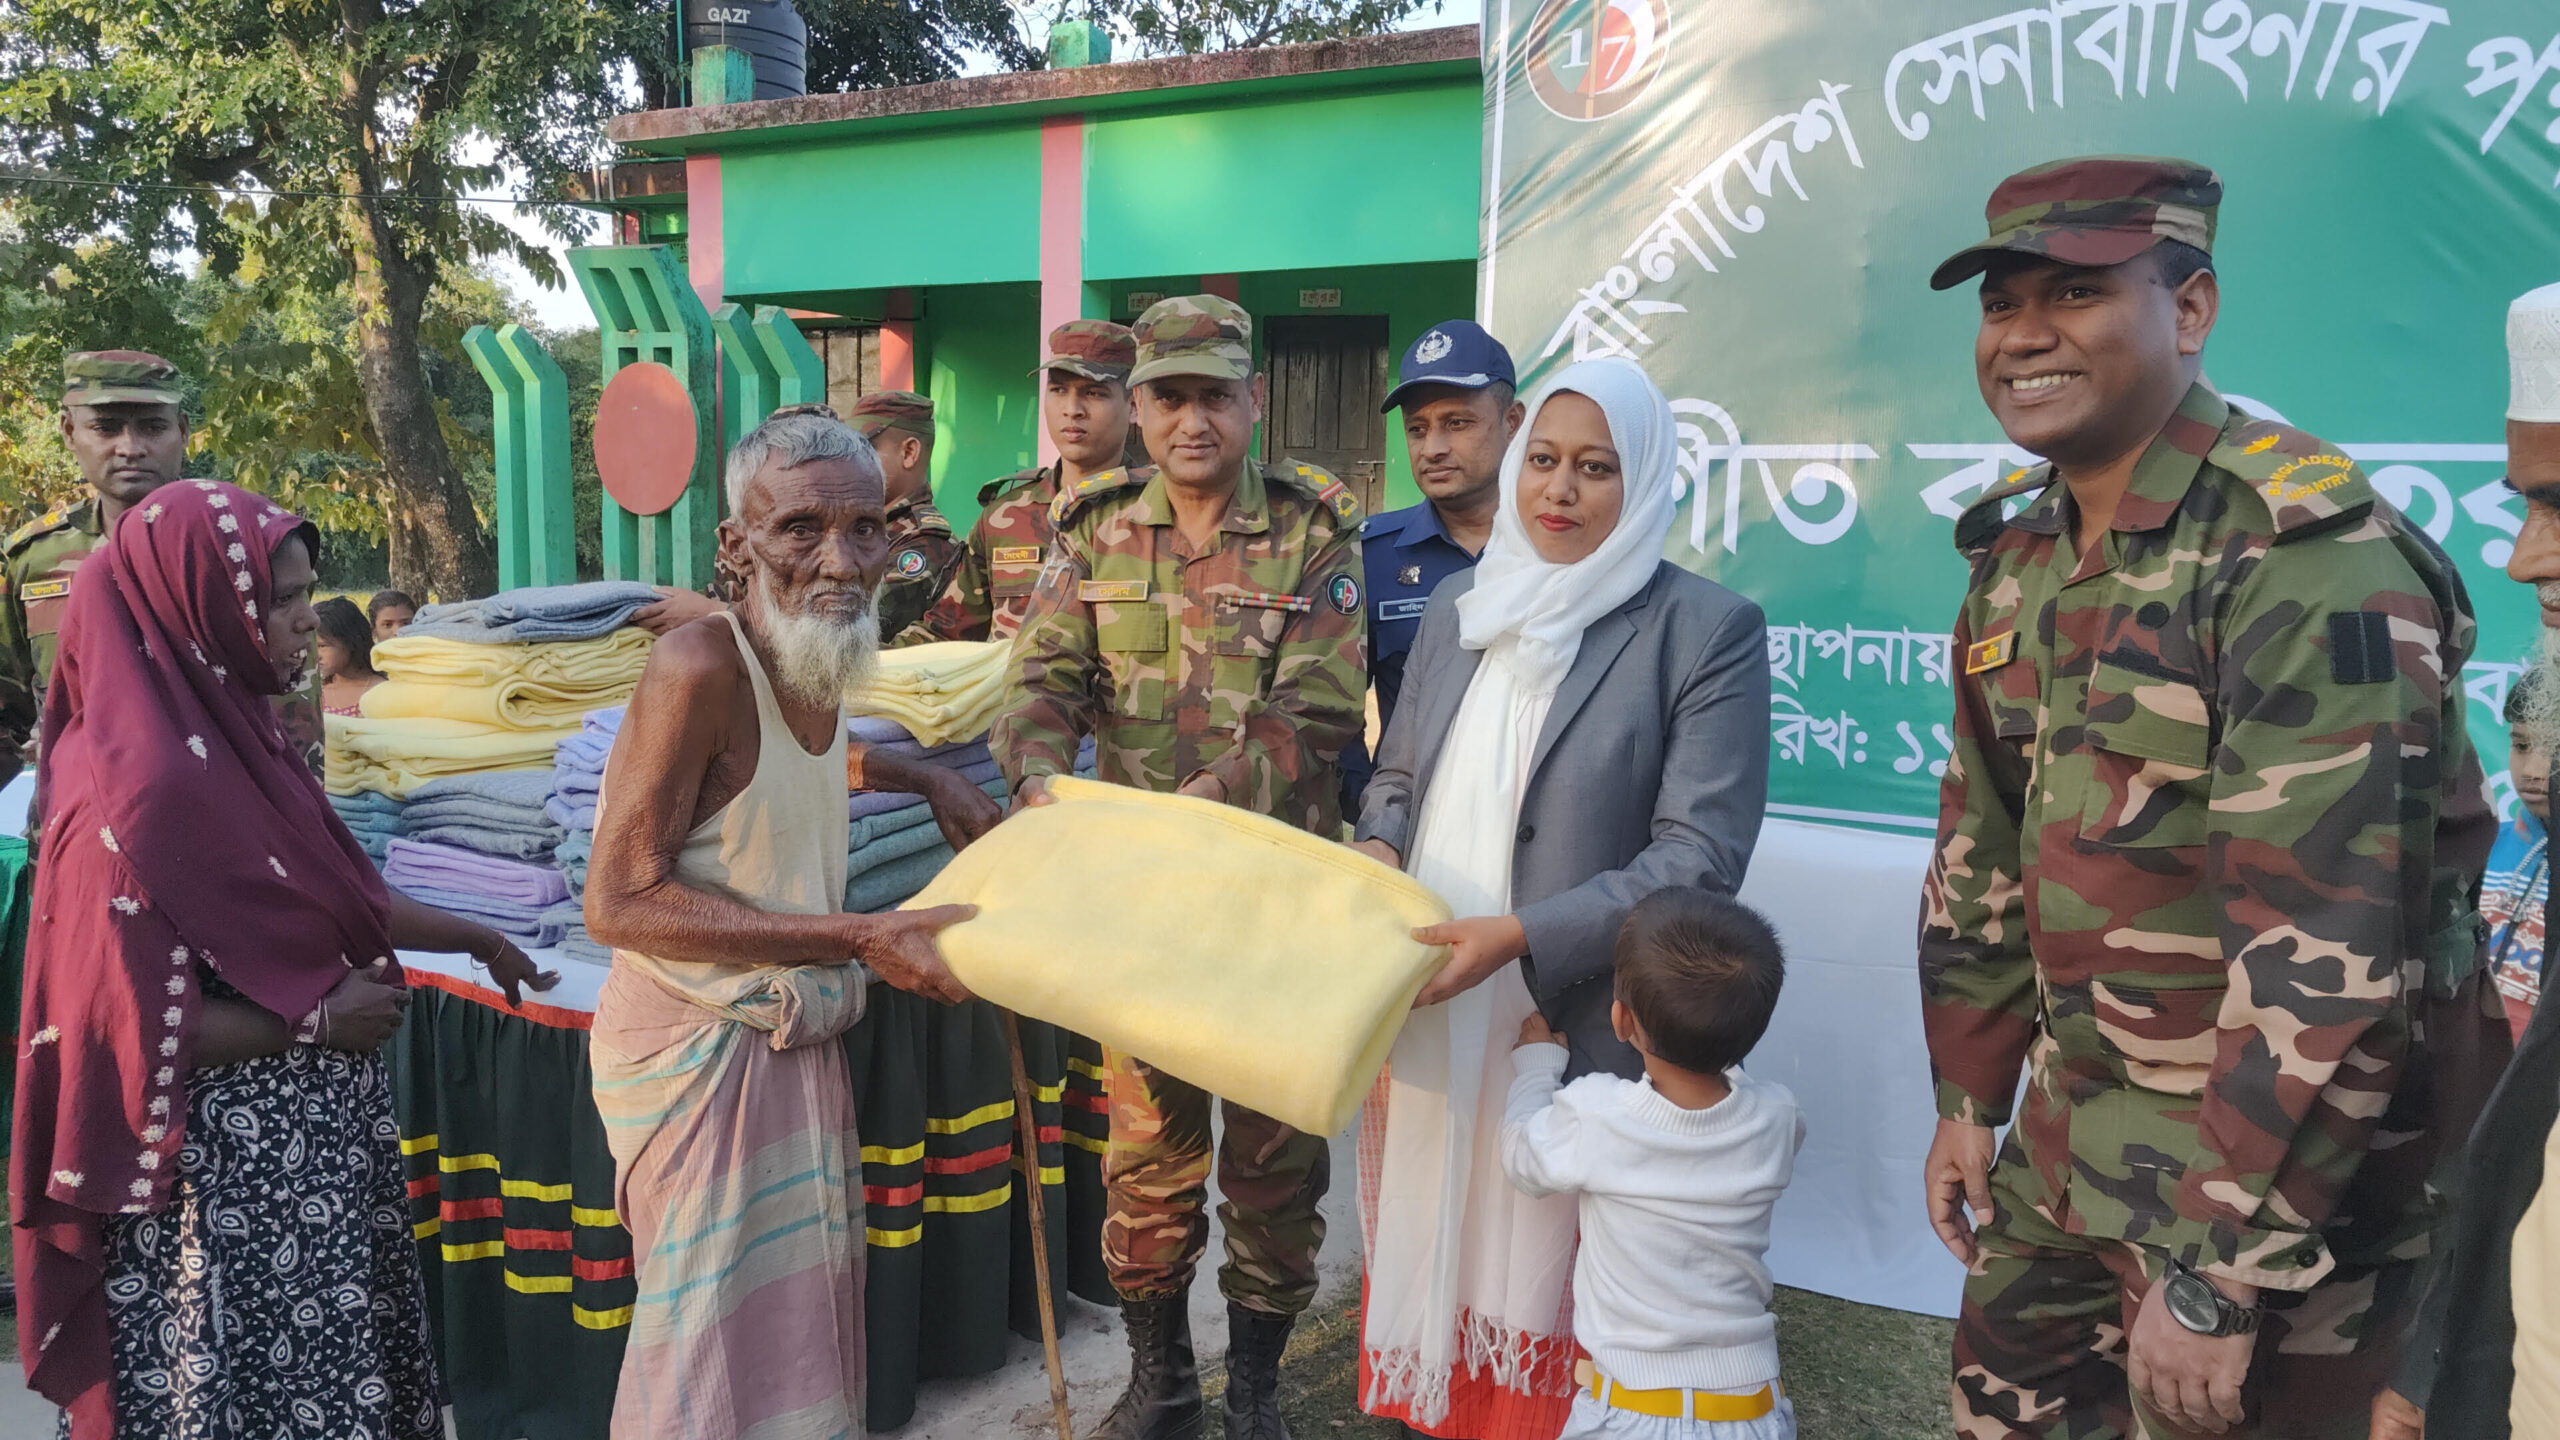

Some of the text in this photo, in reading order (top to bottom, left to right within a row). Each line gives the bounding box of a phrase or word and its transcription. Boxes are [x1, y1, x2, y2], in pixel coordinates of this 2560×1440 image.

[708, 7, 749, 24] GAZI
[1561, 27, 1631, 80] 17
[1540, 79, 1865, 362] বাংলাদেশ
[2267, 455, 2354, 496] BANGLADESH
[2285, 471, 2351, 503] INFANTRY
